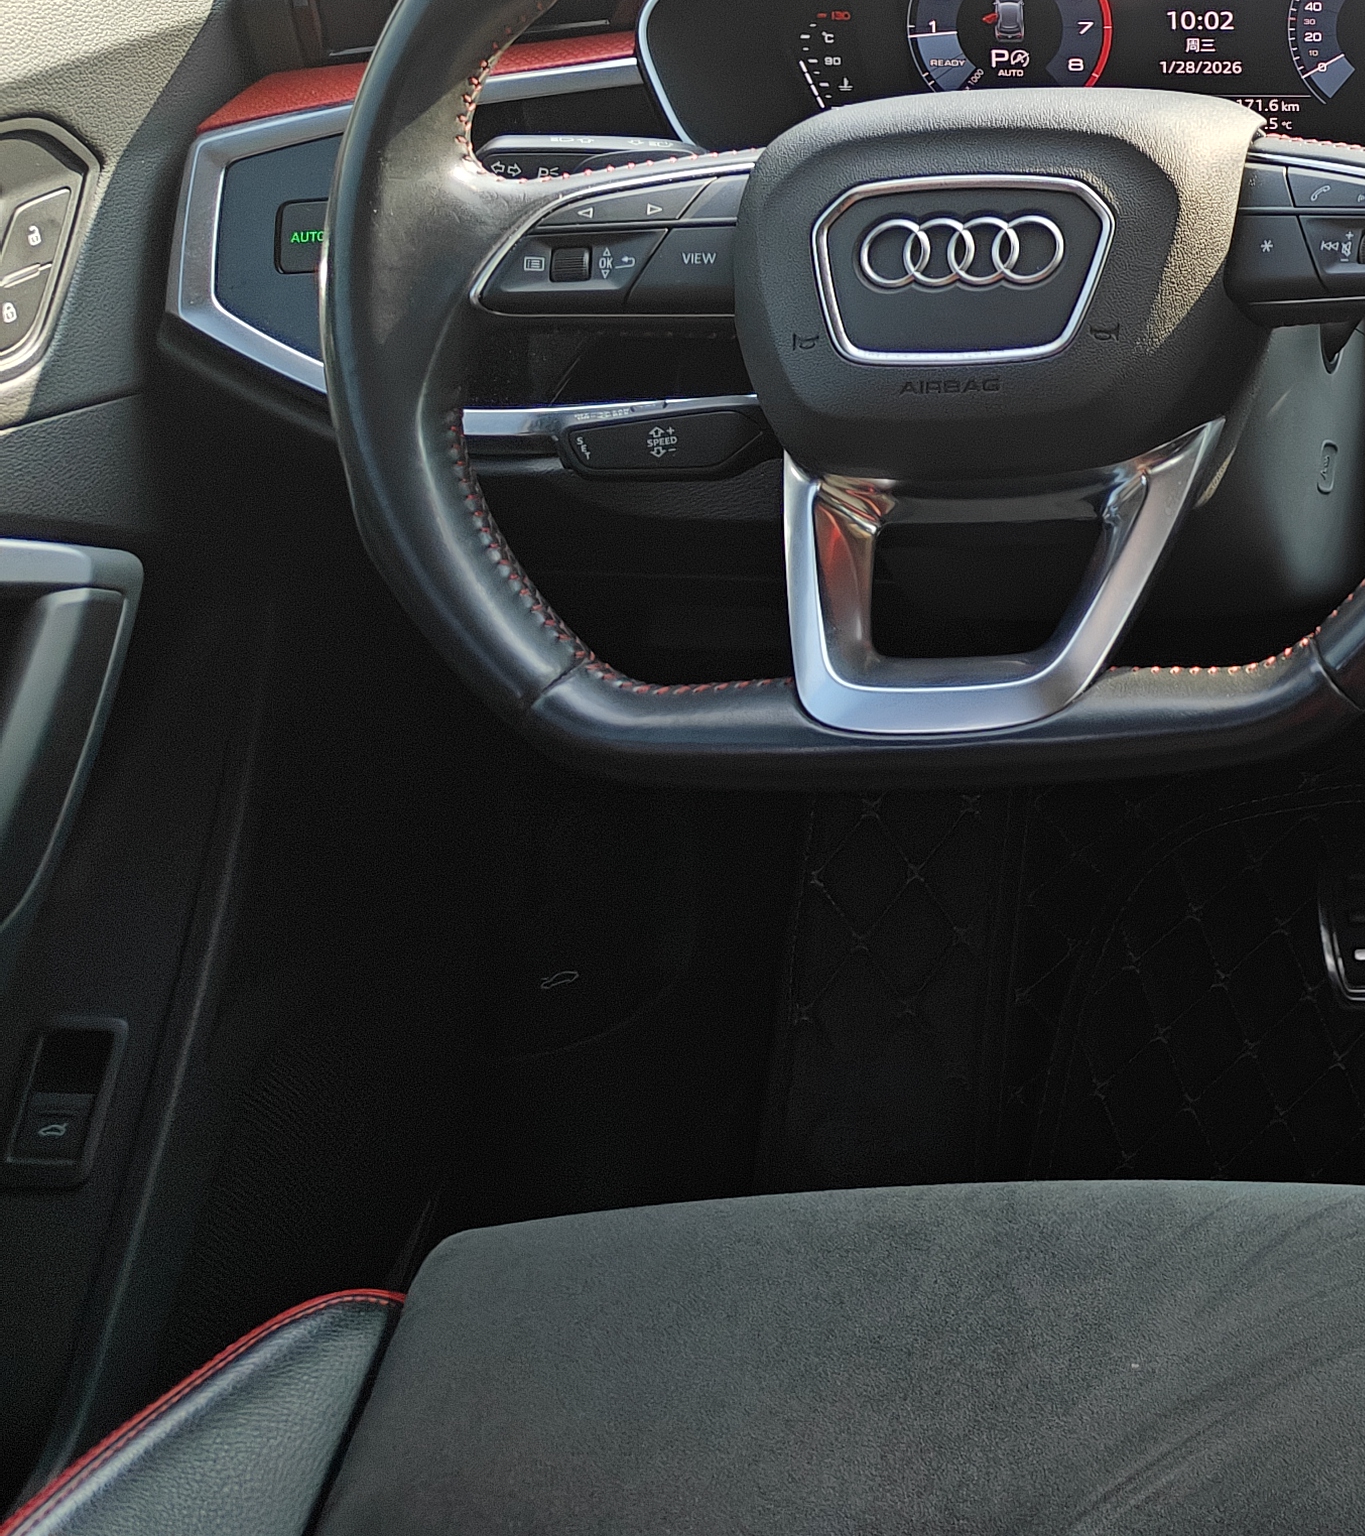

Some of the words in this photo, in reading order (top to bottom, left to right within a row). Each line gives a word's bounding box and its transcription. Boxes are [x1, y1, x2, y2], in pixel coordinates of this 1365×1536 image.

[1304, 2, 1322, 12] 40
[927, 19, 937, 33] 1
[1166, 10, 1235, 31] 10:02
[1077, 21, 1095, 34] 7
[1304, 32, 1322, 42] 20
[1185, 38, 1216, 53] 周三
[824, 56, 841, 66] 90
[929, 59, 967, 67] READY
[990, 49, 1010, 68] P
[1067, 58, 1084, 72] 8
[997, 69, 1024, 77] AUTO
[1159, 61, 1243, 74] 1/28/2026
[1317, 62, 1327, 72] 0
[967, 68, 985, 85] 1000
[1281, 101, 1300, 112] km
[599, 257, 613, 270] OK
[682, 252, 717, 265] VIEW
[900, 378, 1000, 395] AIRBAG
[576, 436, 591, 460] SET
[646, 436, 678, 447] SPEED
